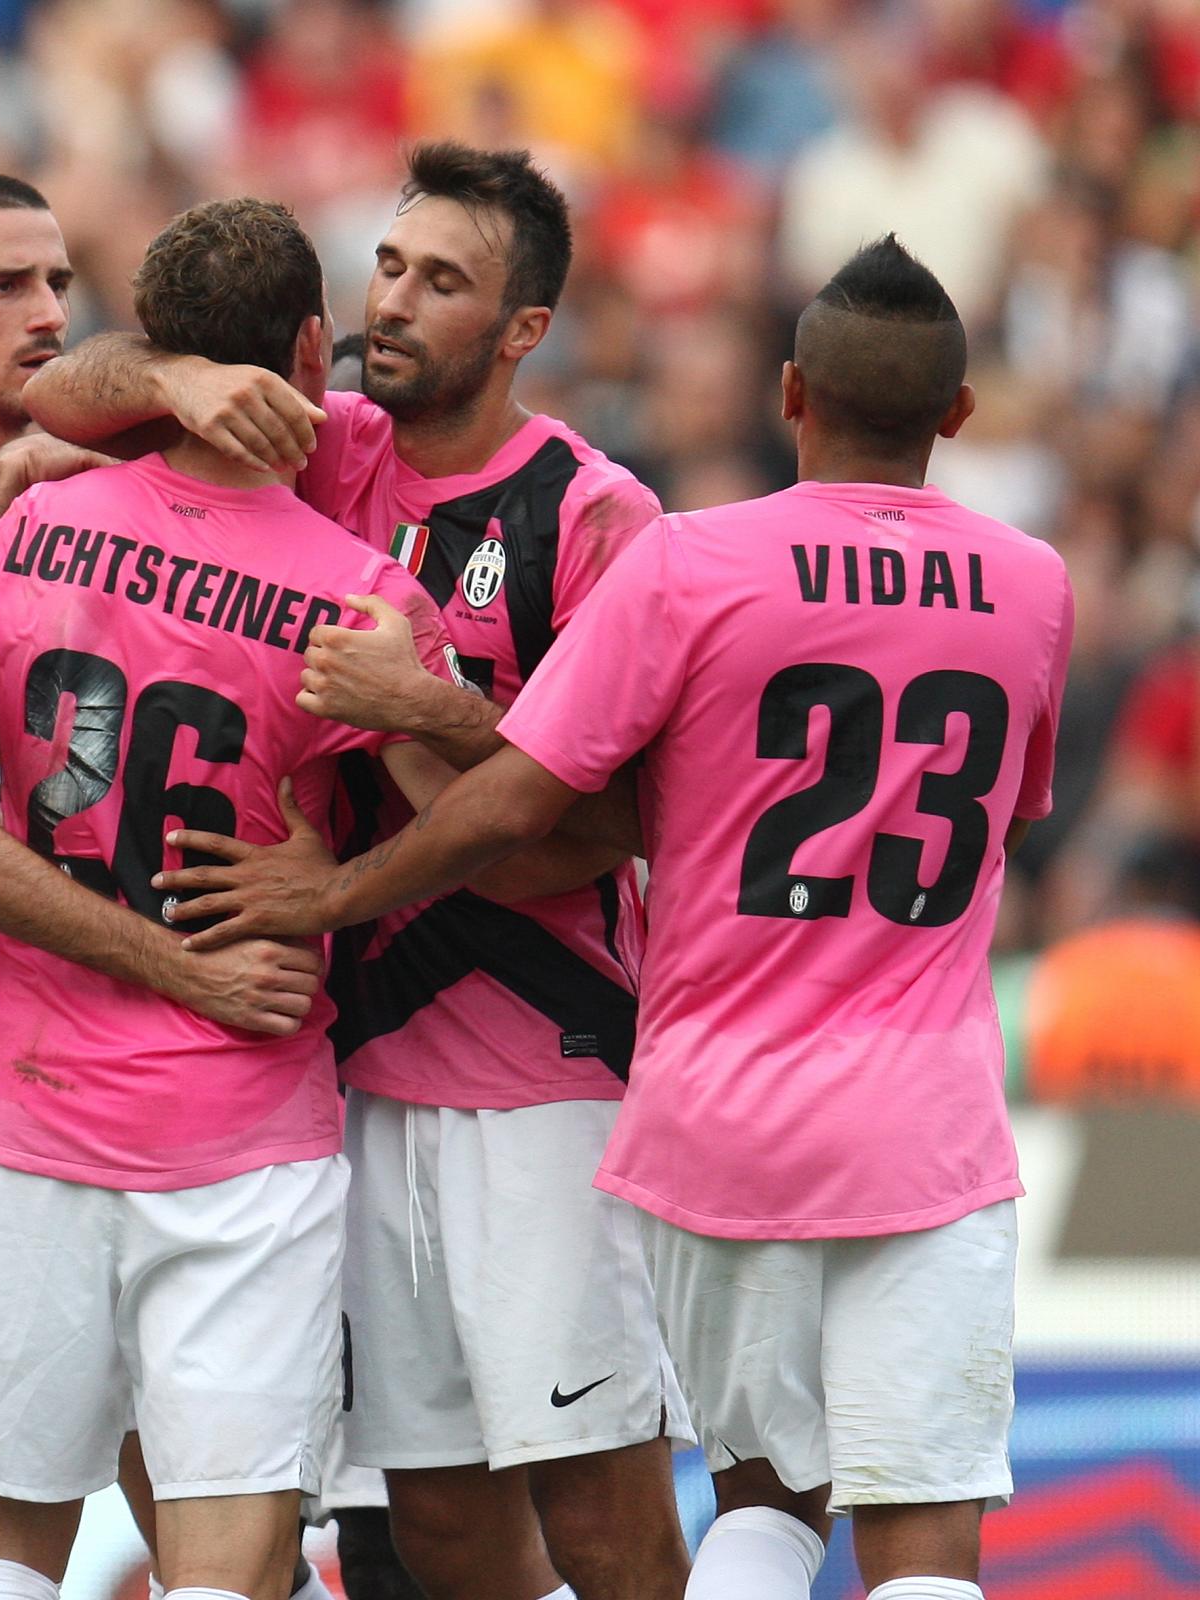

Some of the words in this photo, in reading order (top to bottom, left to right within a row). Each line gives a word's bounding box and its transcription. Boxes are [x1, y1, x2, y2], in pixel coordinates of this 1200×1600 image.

[790, 544, 995, 614] VIDAL
[24, 647, 247, 933] 26
[737, 662, 1009, 927] 23
